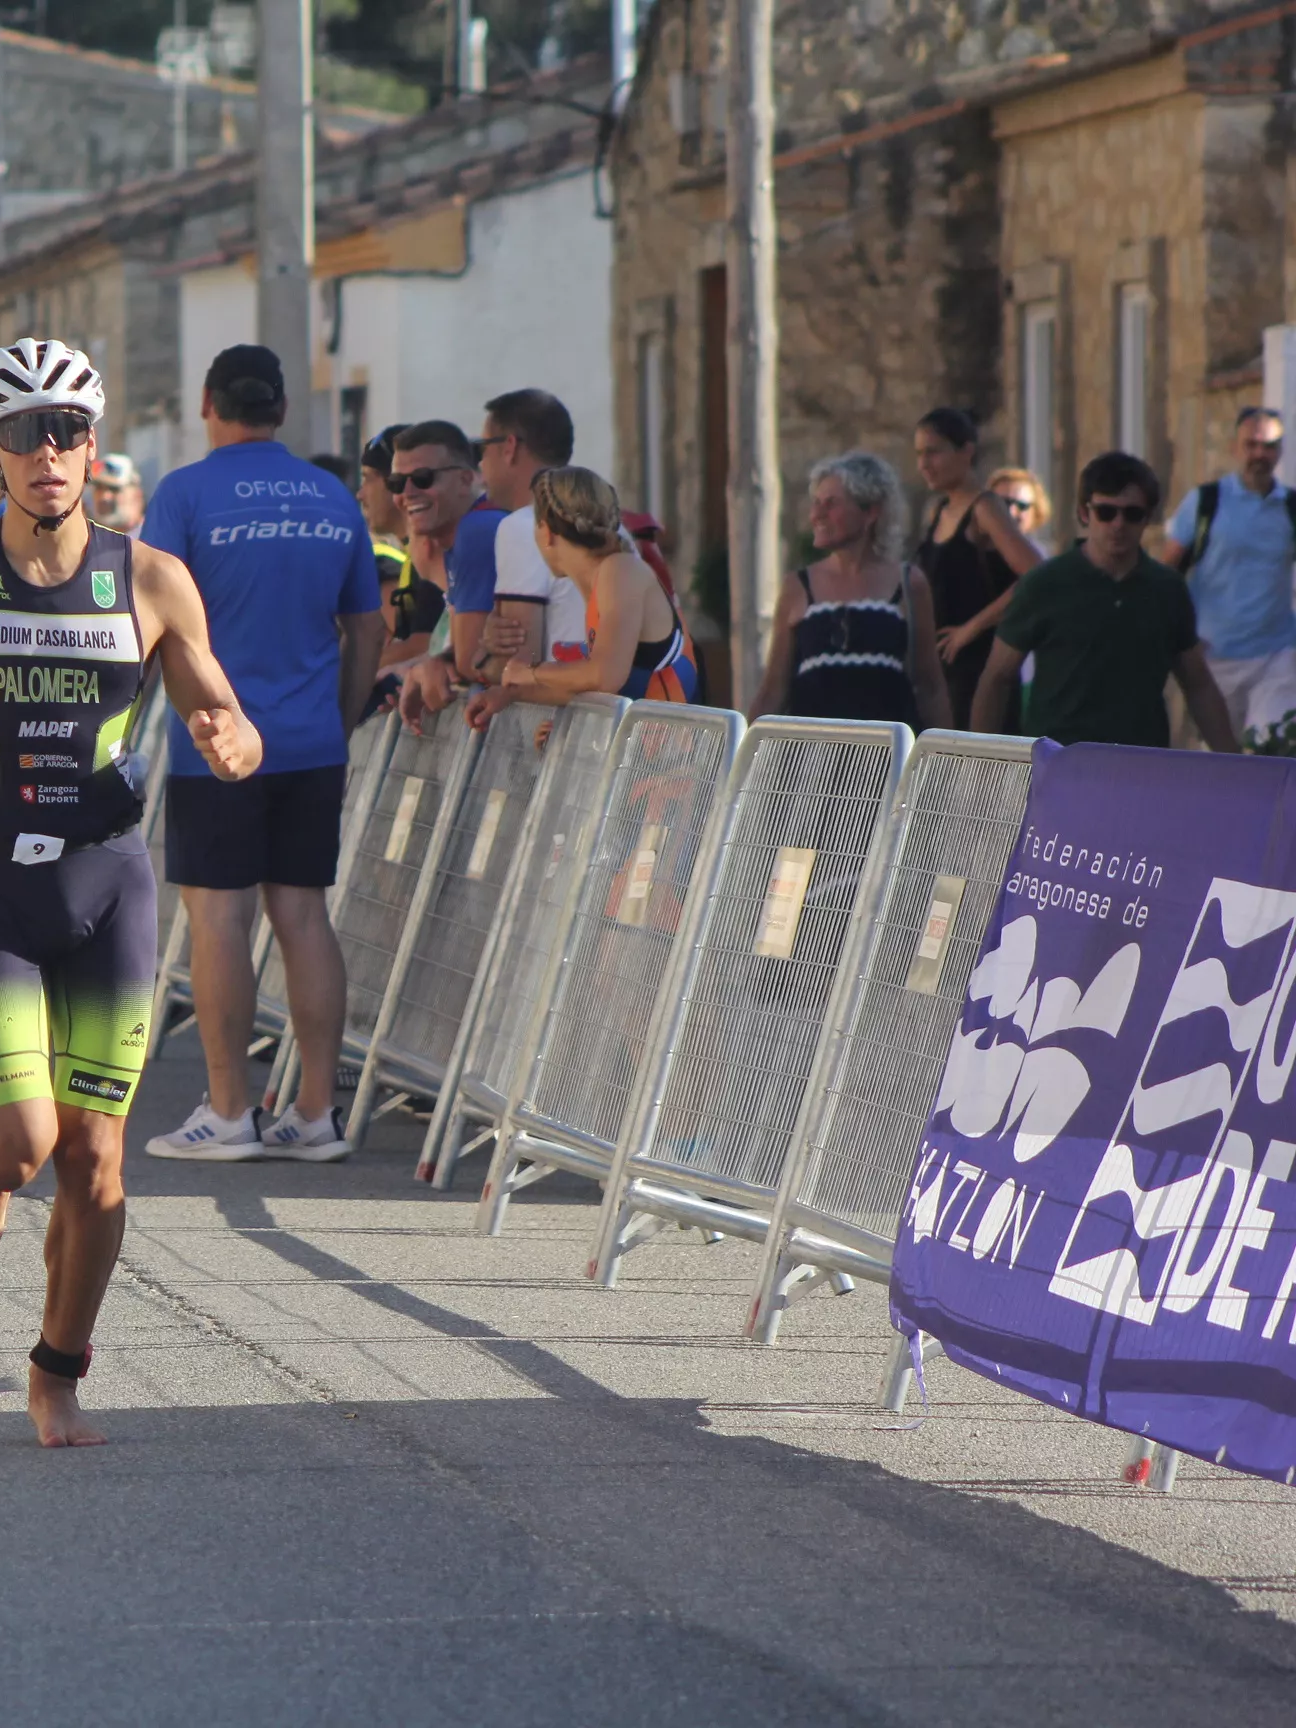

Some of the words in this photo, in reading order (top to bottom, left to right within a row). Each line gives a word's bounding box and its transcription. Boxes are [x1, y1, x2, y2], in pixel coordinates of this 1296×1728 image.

[234, 480, 326, 498] OFICIAL
[35, 628, 117, 650] CASABLANCA
[33, 754, 73, 762] GOBIERNO
[37, 784, 79, 795] Zaragoza
[32, 842, 46, 855] 9
[1022, 825, 1164, 889] federación
[1006, 871, 1112, 919] aragonesa
[1122, 895, 1149, 928] de
